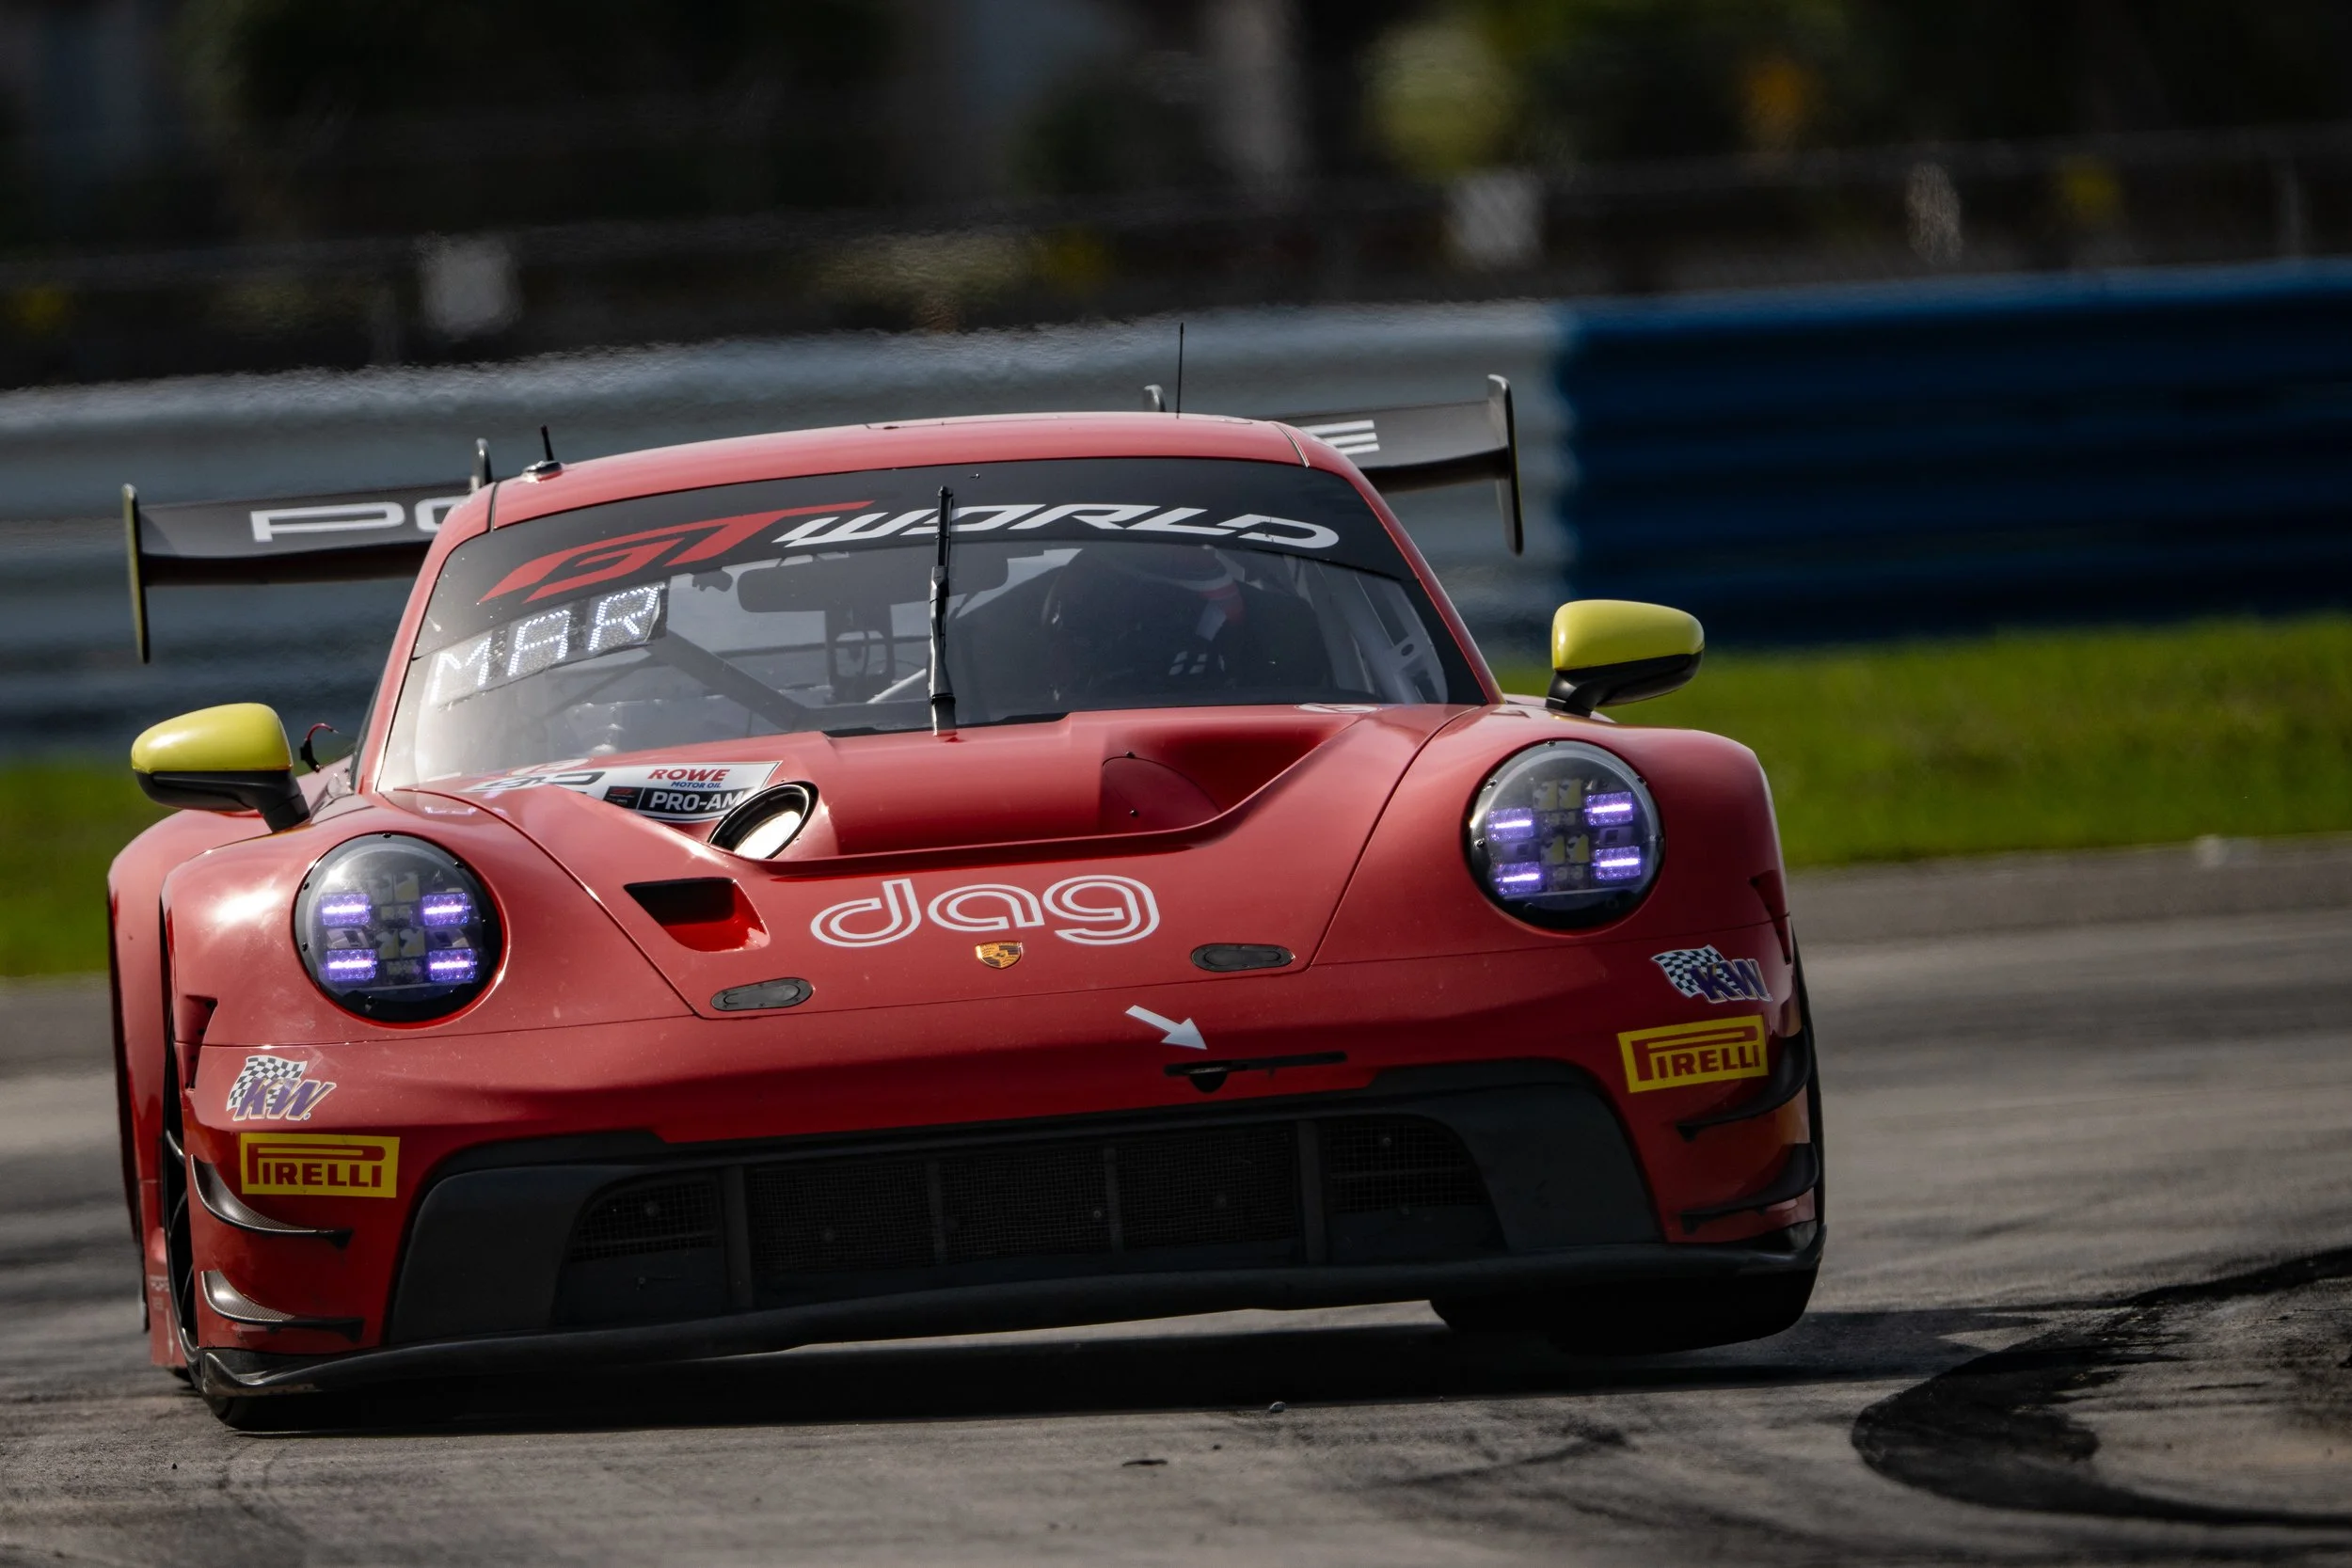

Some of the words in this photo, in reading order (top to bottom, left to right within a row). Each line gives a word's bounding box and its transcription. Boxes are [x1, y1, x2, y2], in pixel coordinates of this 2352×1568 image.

[430, 579, 664, 704] MAR
[647, 768, 730, 782] ROWE
[670, 781, 706, 789] MOTOR
[648, 790, 744, 812] PRO-AM
[810, 874, 1161, 948] dag
[1691, 958, 1770, 1004] KW
[1630, 1025, 1761, 1082] PIRELLI
[233, 1078, 337, 1121] KW
[246, 1143, 387, 1188] PIRELLI
